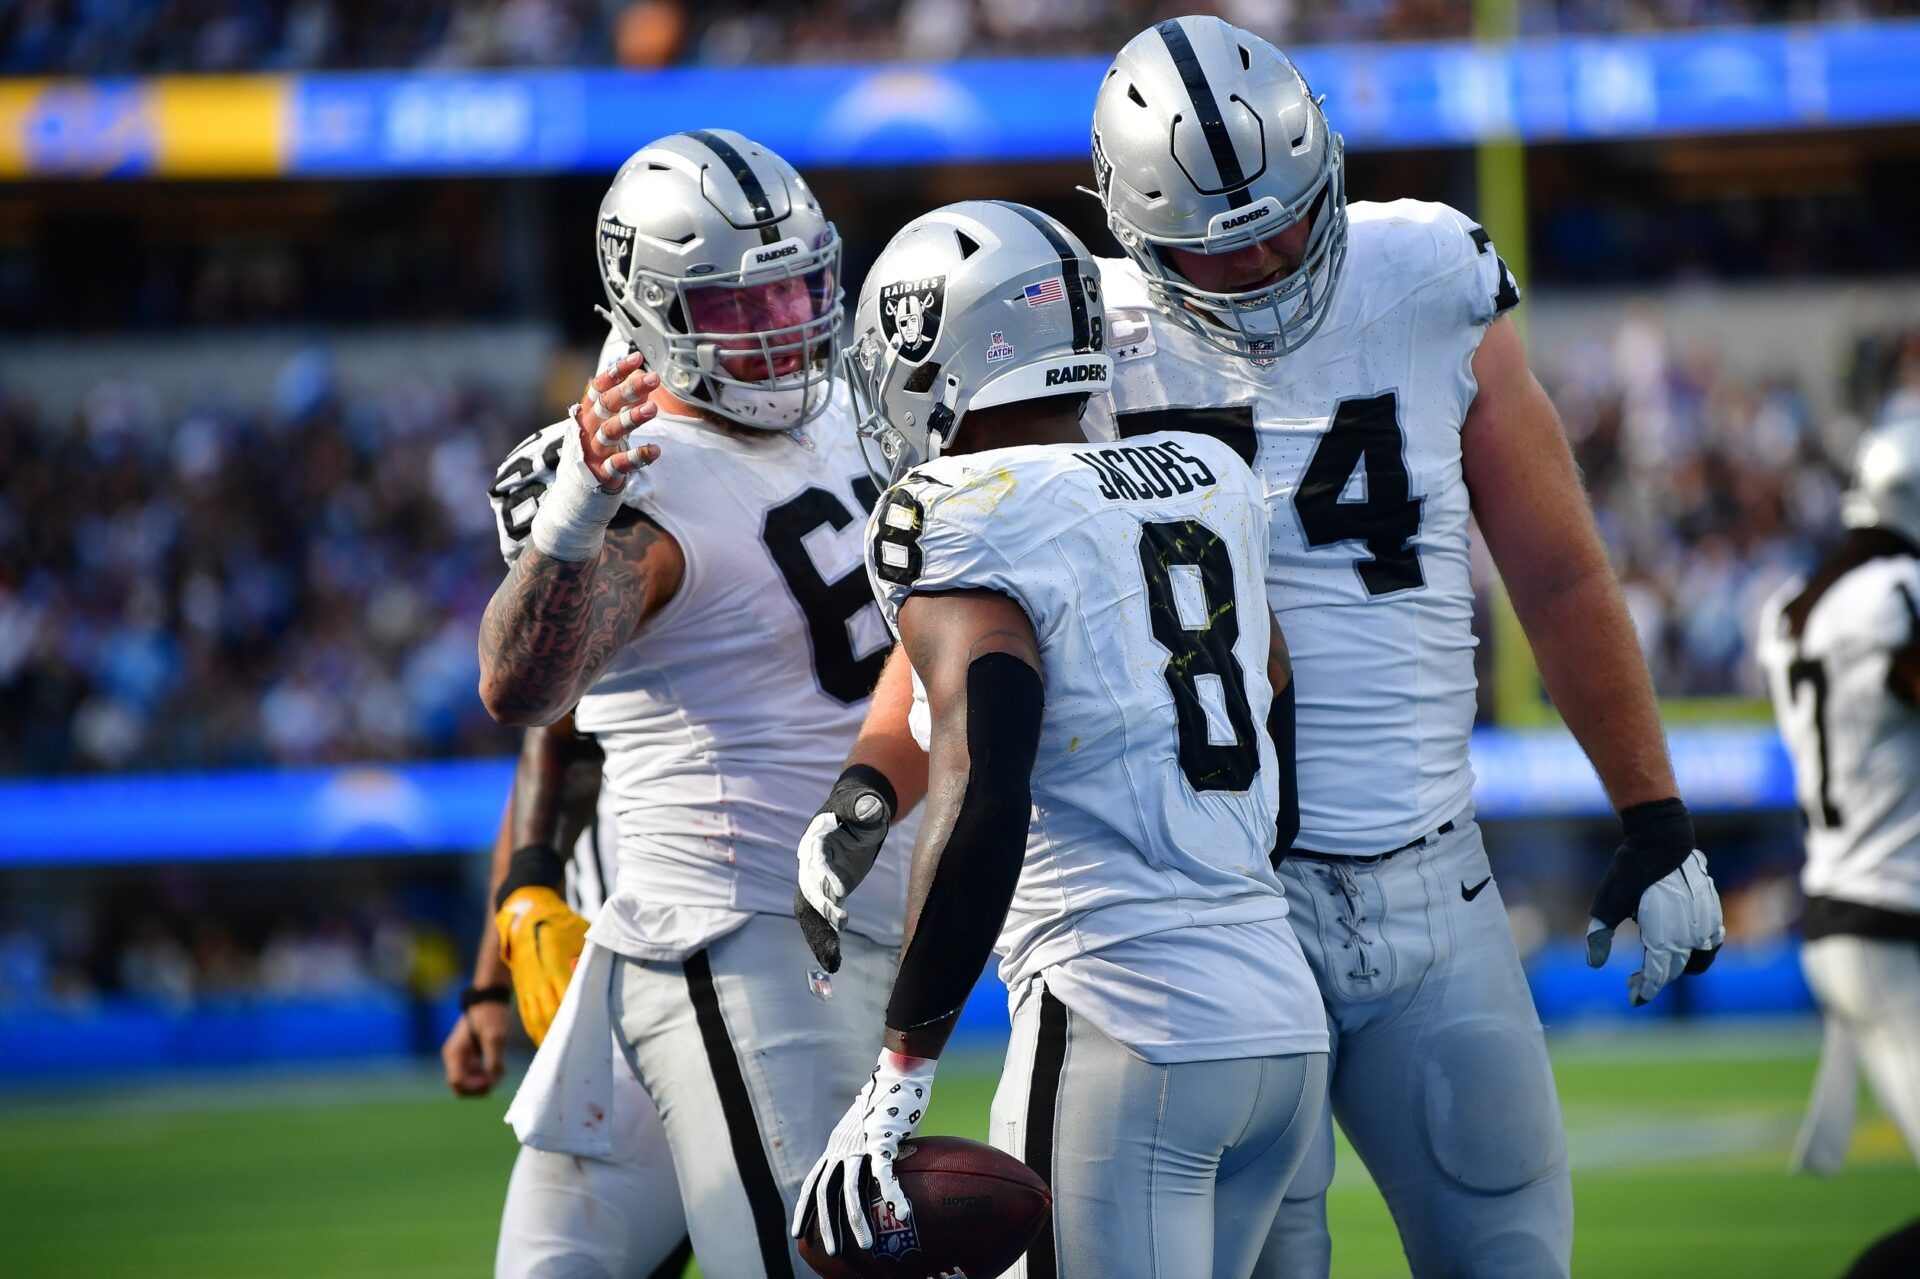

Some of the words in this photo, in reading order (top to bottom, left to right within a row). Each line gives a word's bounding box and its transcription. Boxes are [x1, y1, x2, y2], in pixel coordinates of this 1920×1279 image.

[1221, 205, 1270, 231] RAIDERS
[755, 244, 798, 263] RAIDERS
[884, 278, 938, 298] RAIDERS
[1090, 316, 1103, 351] 8
[988, 346, 1013, 359] CATCH
[1045, 363, 1107, 387] RAIDERS
[1071, 440, 1216, 500] JACOBS
[874, 488, 923, 585] 8
[760, 469, 896, 704] 6
[1137, 517, 1261, 793] 8
[908, 1109, 921, 1125] 8
